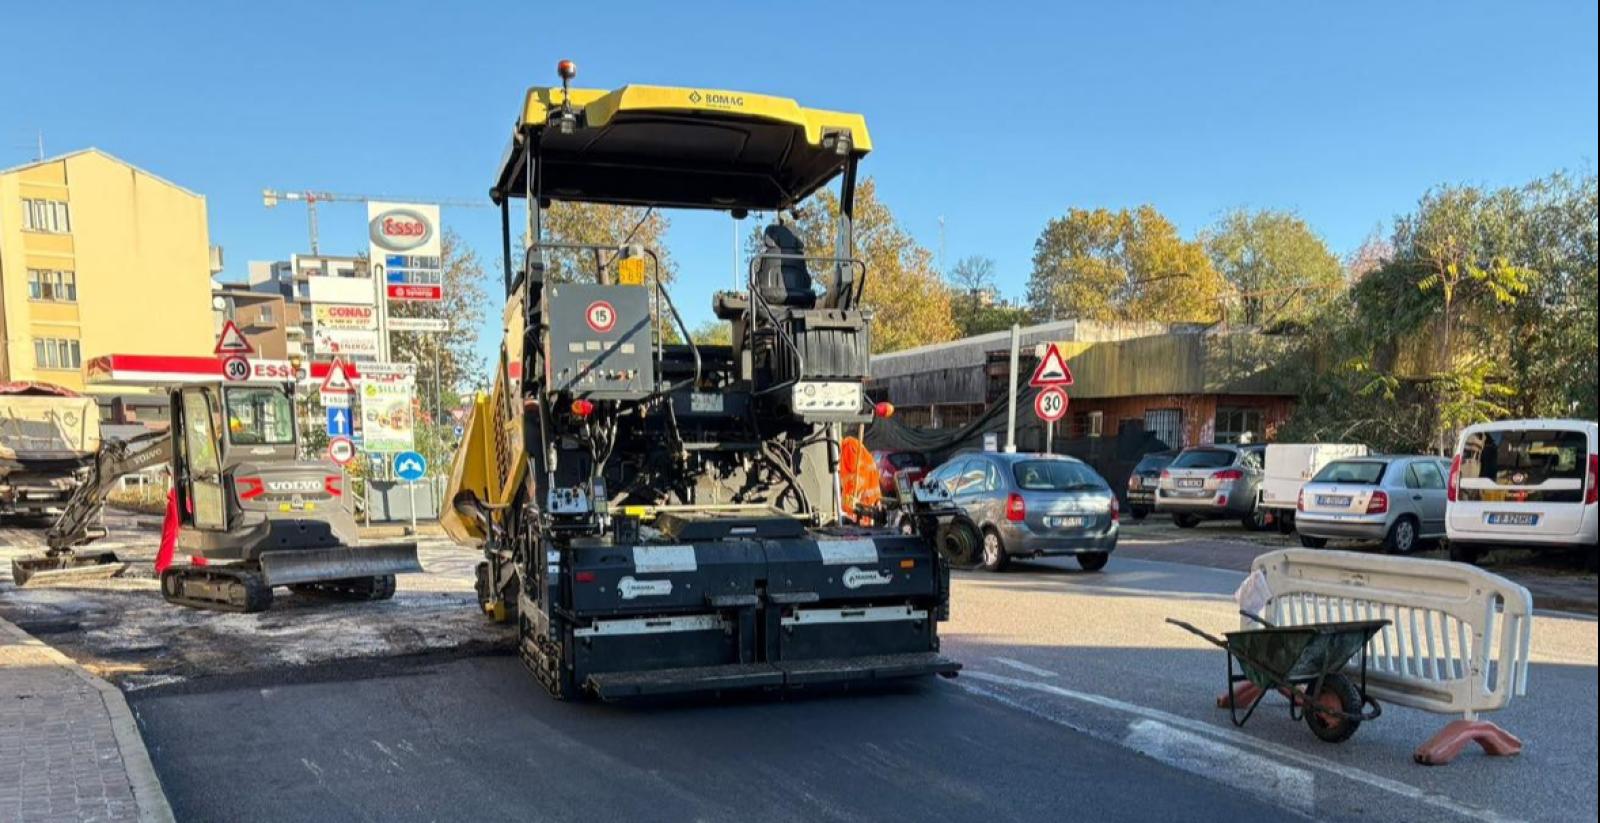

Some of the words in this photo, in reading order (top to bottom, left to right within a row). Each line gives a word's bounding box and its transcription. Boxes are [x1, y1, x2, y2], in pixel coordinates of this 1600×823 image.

[705, 93, 744, 106] BOMAG
[329, 307, 372, 317] CONAD
[595, 310, 607, 322] 15
[229, 362, 245, 376] 30
[1044, 395, 1060, 411] 30
[267, 480, 321, 491] VOLVO
